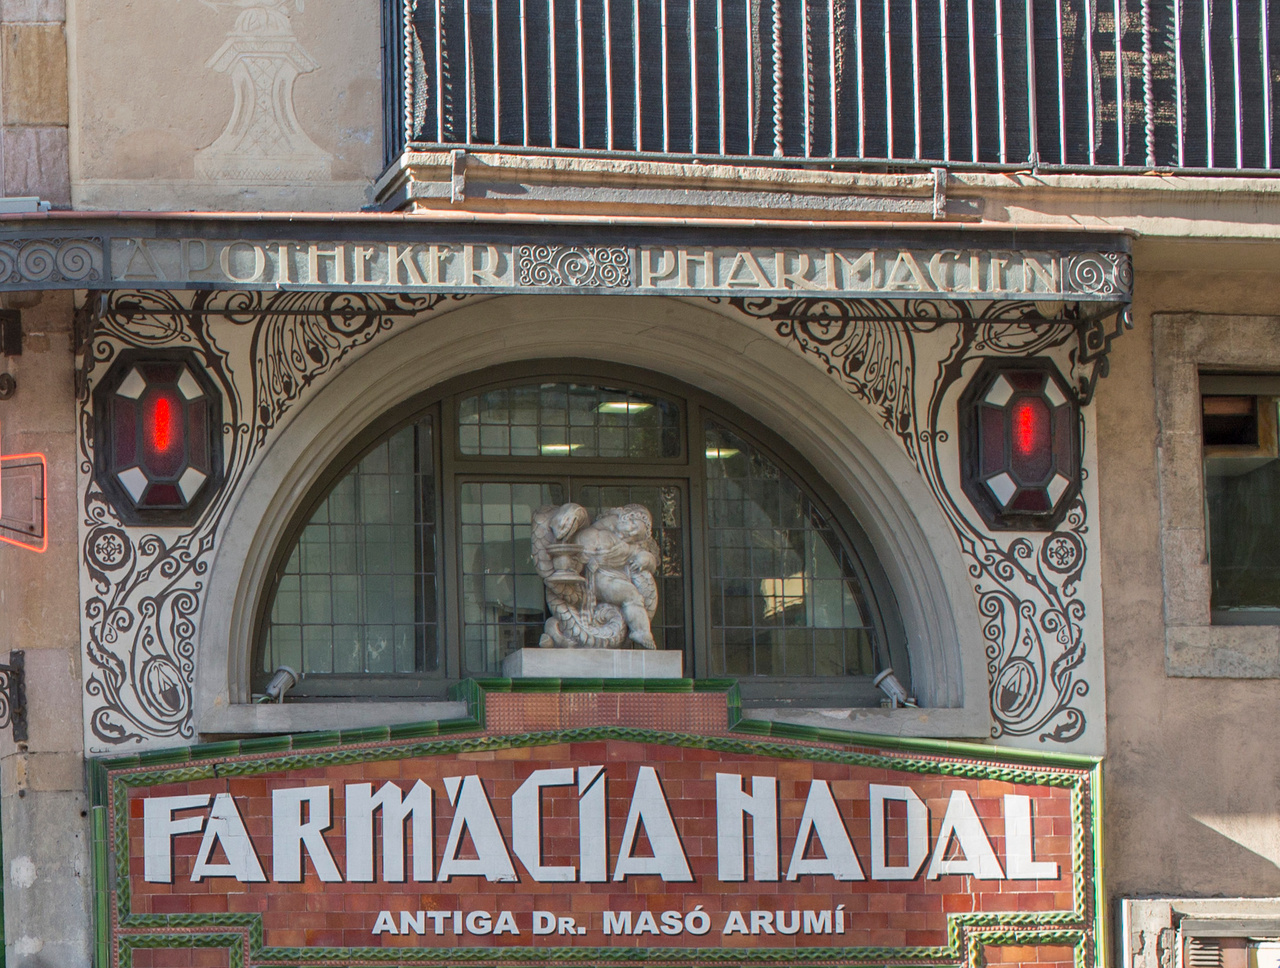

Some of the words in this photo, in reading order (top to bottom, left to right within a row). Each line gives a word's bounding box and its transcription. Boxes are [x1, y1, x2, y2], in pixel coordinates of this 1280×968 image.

[119, 238, 511, 287] APOTHEKER
[640, 247, 1062, 293] PHARMACIEN
[717, 772, 1062, 880] NADAL
[372, 911, 519, 936] ANTIGA
[602, 903, 711, 936] MASÓ
[722, 903, 846, 936] ARUMÍ
